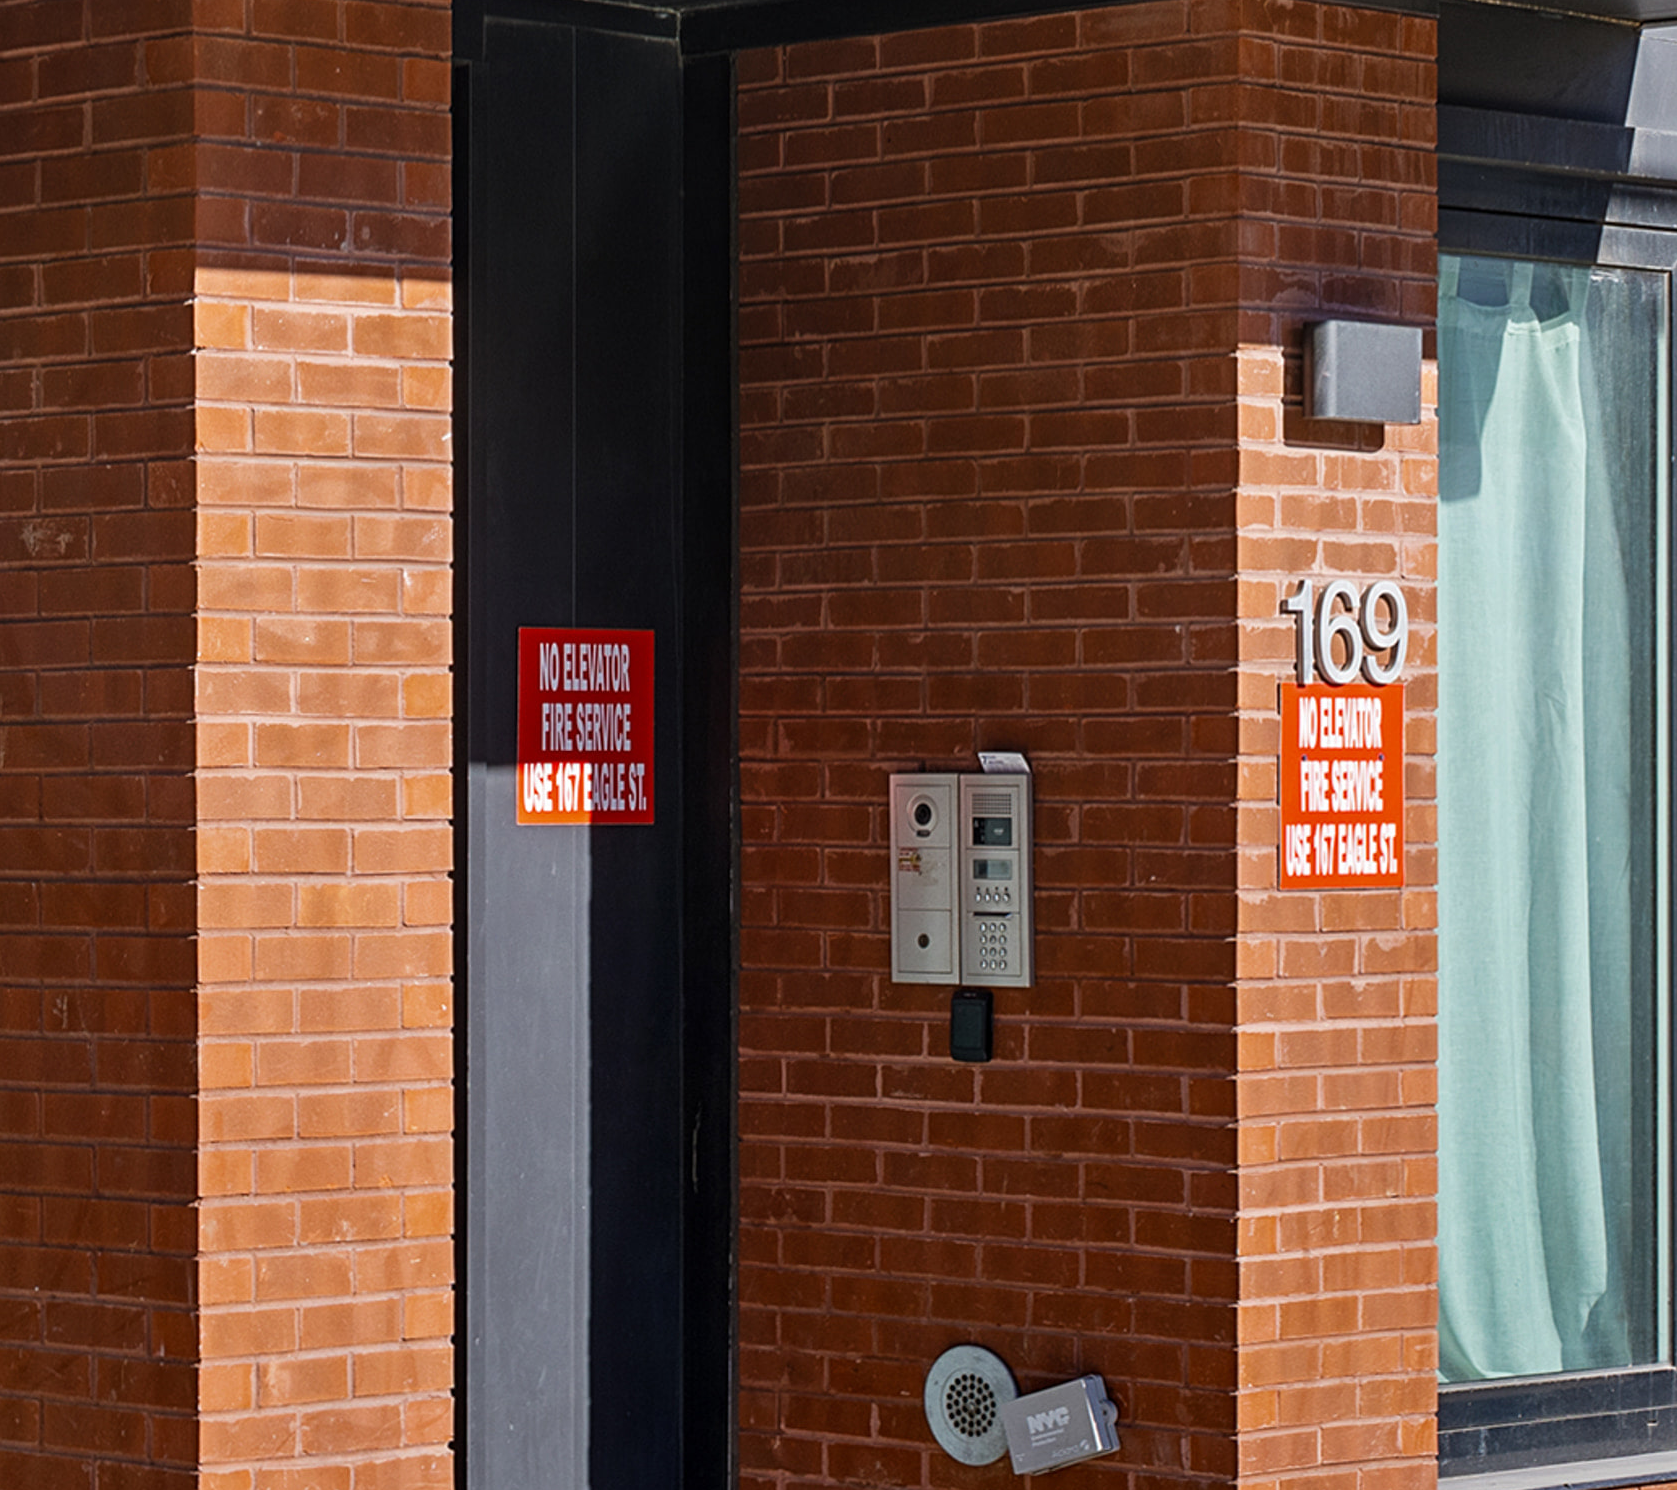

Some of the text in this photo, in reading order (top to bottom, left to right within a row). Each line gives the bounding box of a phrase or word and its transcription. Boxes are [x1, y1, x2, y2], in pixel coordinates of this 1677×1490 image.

[1283, 580, 1408, 685] 169
[539, 643, 630, 692] NO ELEVATOR
[542, 703, 631, 752] FIRE SERVICE
[1299, 696, 1382, 750] NO ELEVATOR
[523, 762, 646, 813] USE 167 EAGLE ST.
[1301, 760, 1383, 812] FIRE SERVICE
[1285, 823, 1397, 876] USE 167 EAGLE ST.
[1026, 1406, 1071, 1435] NYC
